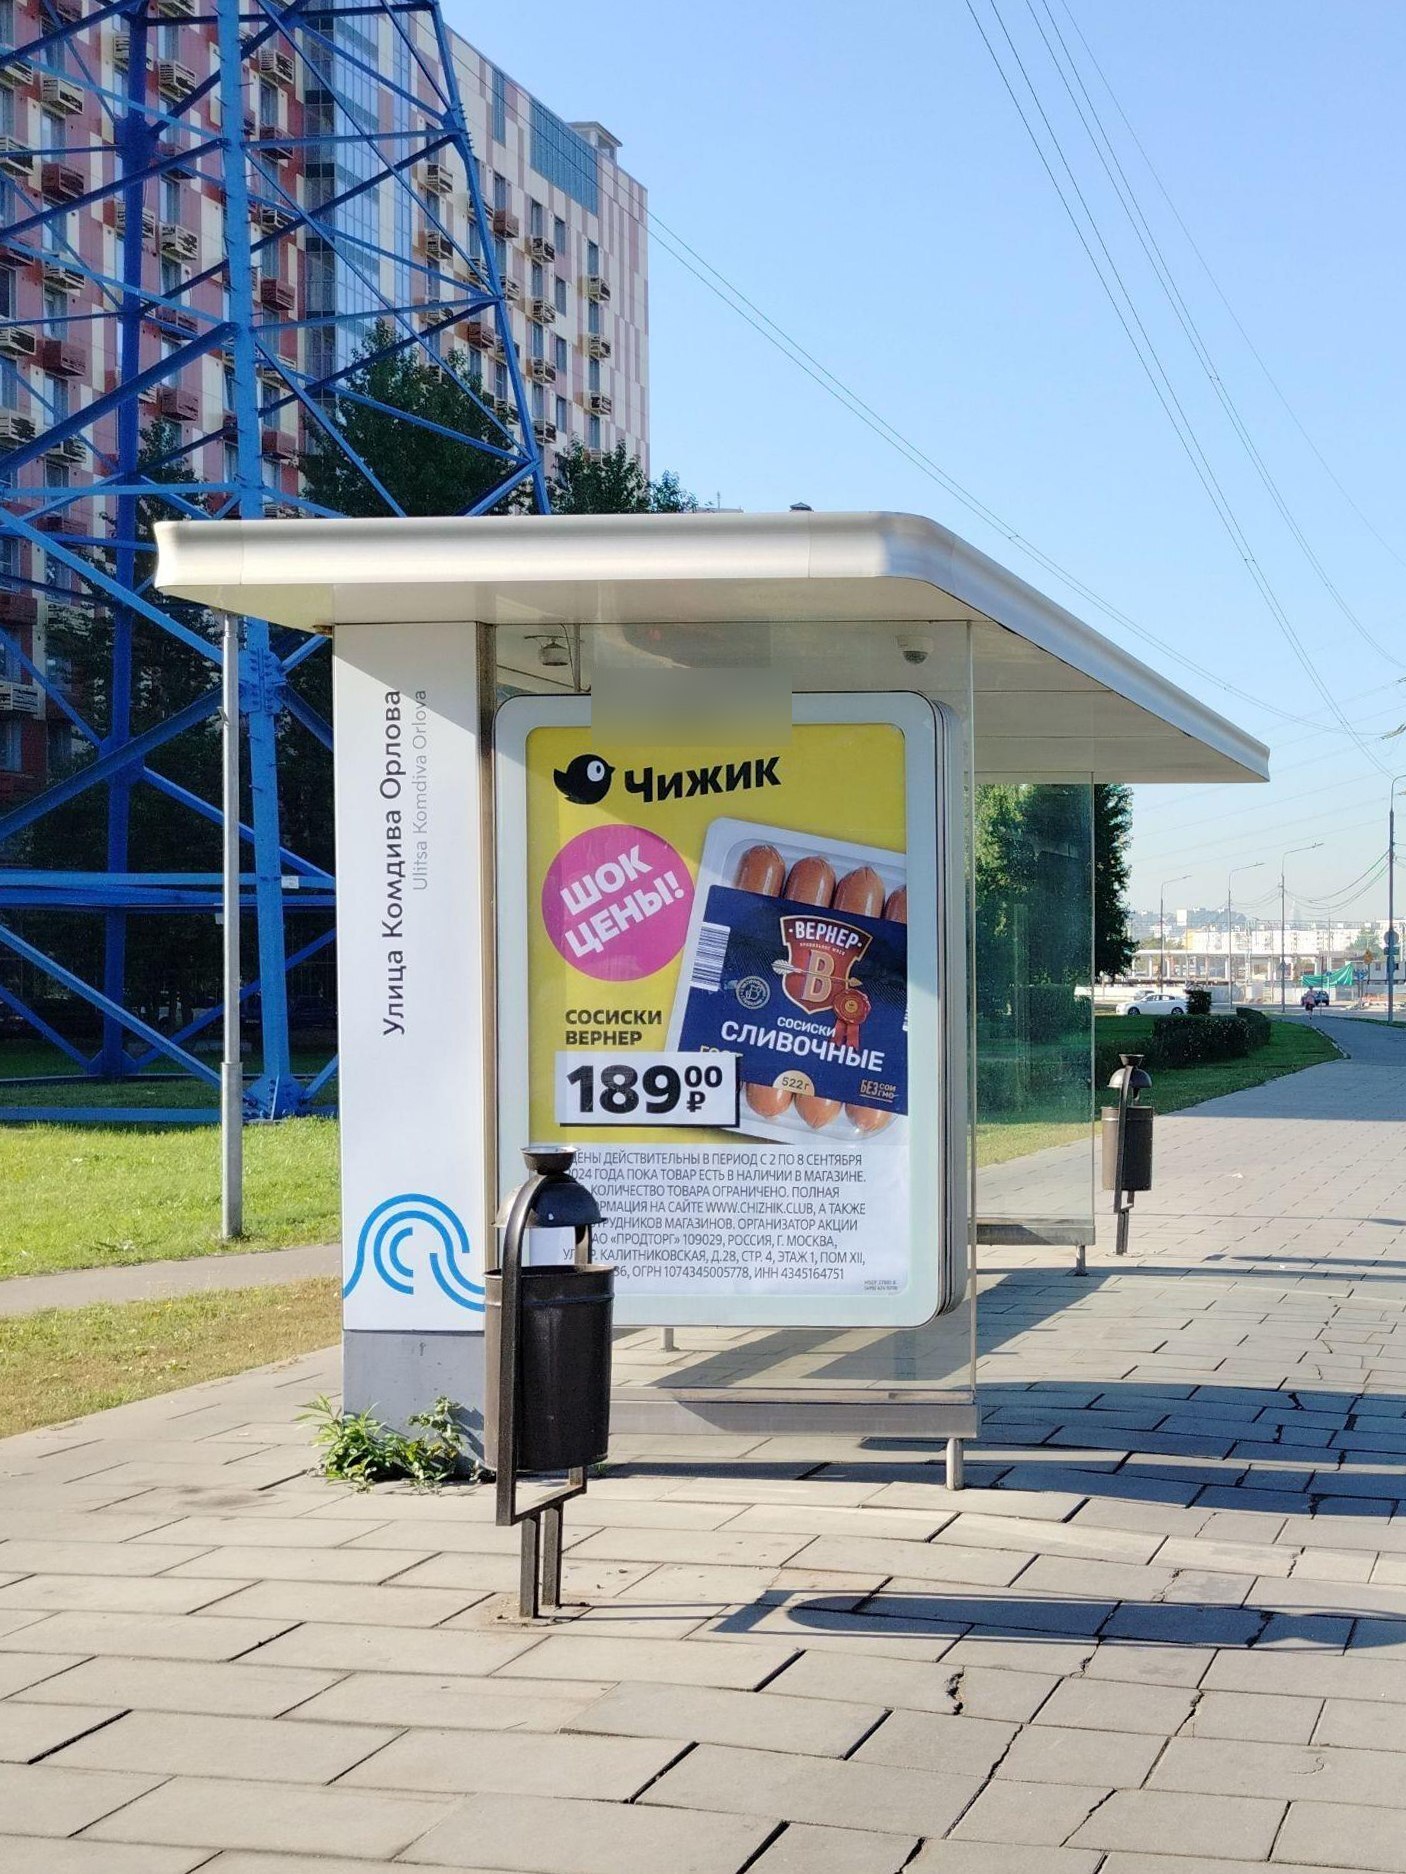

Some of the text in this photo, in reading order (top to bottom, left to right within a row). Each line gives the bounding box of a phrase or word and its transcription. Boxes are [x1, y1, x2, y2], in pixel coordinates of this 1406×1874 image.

[411, 690, 428, 890] Ulitsa Komdiva Orlova
[380, 690, 406, 1036] Улица Комдива Орлова
[559, 845, 653, 917] ШОК
[565, 871, 685, 958] ЦЕНЫ!
[795, 921, 858, 949] ВЕРНЕР
[565, 1009, 662, 1025] СОСИСКИ
[777, 1016, 836, 1038] СОСИСКИ
[565, 1030, 643, 1045] ВЕРНЕР
[721, 1021, 885, 1072] СЛИВОЧНЫЕ
[566, 1064, 681, 1114] 189
[684, 1065, 723, 1088] 00
[860, 1080, 896, 1095] БЕЗ СОИ
[879, 1090, 895, 1099] ГМО
[603, 1150, 700, 1165] ДЕЙСТВИТЕЛЬНЫ
[703, 1153, 710, 1164] В
[712, 1153, 757, 1167] ПЕРИОД
[760, 1154, 768, 1165] С
[769, 1154, 776, 1165] 2
[778, 1154, 795, 1165] ПО
[797, 1154, 804, 1165] 8
[806, 1154, 862, 1166] СЕНТЯБРЯ
[595, 1169, 624, 1182] ГОДА
[626, 1169, 658, 1181] ПОКА
[660, 1169, 697, 1181] ТОВАР
[700, 1170, 725, 1181] ЕСТЬ
[727, 1170, 734, 1181] В
[737, 1170, 793, 1182] НАЛИЧИИ
[795, 1171, 802, 1182] В
[804, 1171, 866, 1182] МАГАЗИНЕ.
[591, 1185, 840, 1198] КОЛИЧЕСТВО ТОВАРА ОГРАНИЧЕНО. ПОЛНАЯ
[598, 1199, 866, 1216] РМАЦИЯ НА САЙТЕ WWW.CHIZHIK.CLUB, А ТАКЖЕ
[665, 1218, 735, 1230] МАГАЗИНОВ.
[738, 1219, 816, 1231] ОРГАНИЗАТОР
[818, 1219, 858, 1233] АКЦИИ
[611, 1234, 679, 1246] «ПРОДТОРГ»
[683, 1235, 725, 1247] 109029,
[728, 1235, 774, 1248] РОССИЯ,
[777, 1235, 785, 1246] Г.
[787, 1236, 838, 1249] МОСКВА,
[601, 1250, 709, 1262] КАЛИТНИКОВСКАЯ,
[711, 1250, 740, 1264] Д.28,
[742, 1251, 763, 1262] СТР.
[765, 1252, 775, 1264] 4,
[777, 1252, 807, 1263] ЭТАЖ
[811, 1252, 818, 1265] 1,
[821, 1252, 847, 1264] ПОМ
[632, 1266, 662, 1278] ОГРН
[665, 1266, 752, 1280] 1074345005778,
[754, 1268, 778, 1279] ИНН
[781, 1268, 844, 1280] 4345164751
